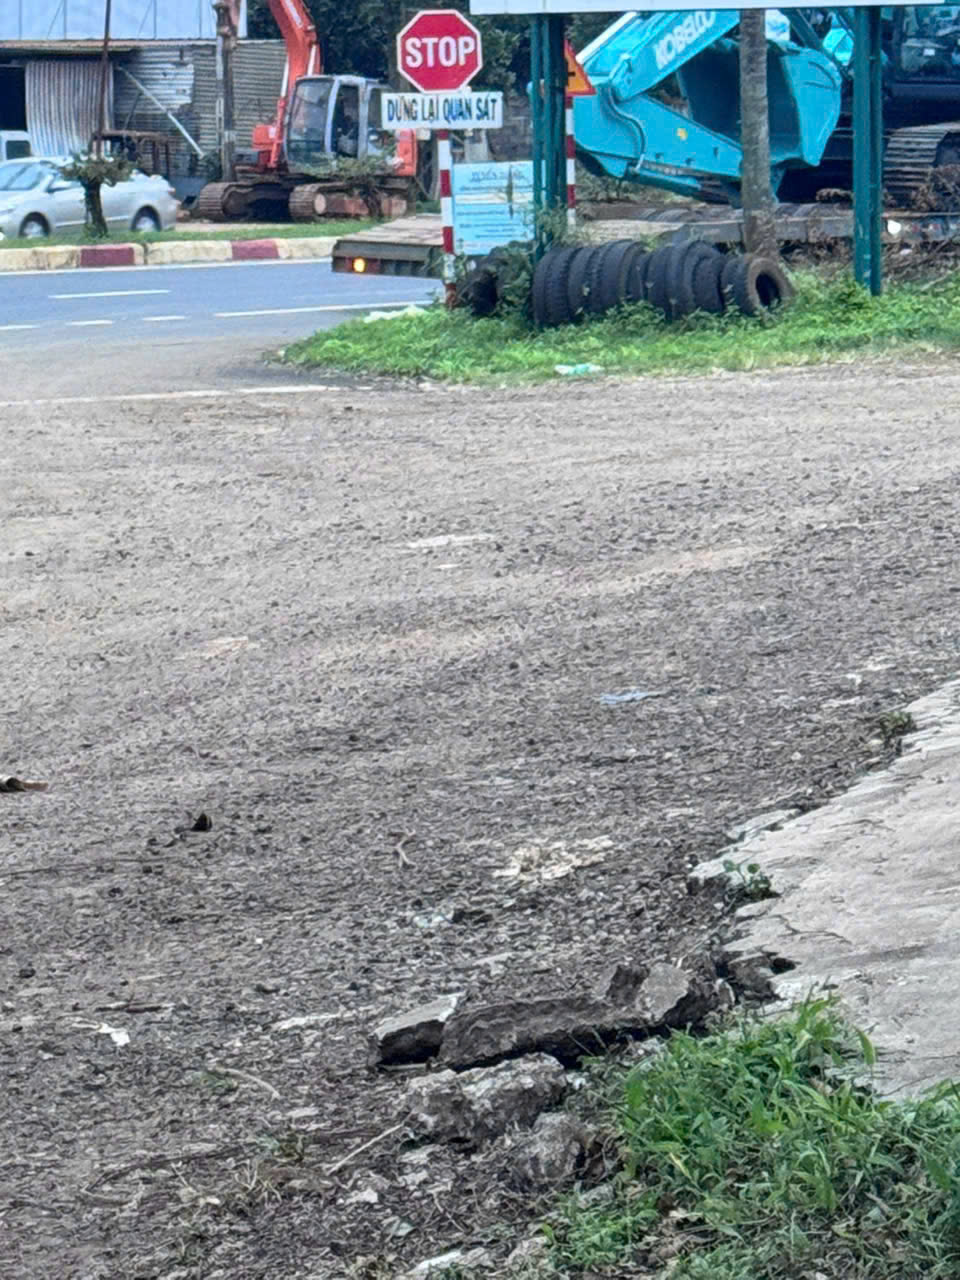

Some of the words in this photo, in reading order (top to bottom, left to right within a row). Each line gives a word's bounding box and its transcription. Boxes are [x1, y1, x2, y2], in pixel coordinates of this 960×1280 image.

[405, 36, 476, 68] STOP
[443, 98, 472, 124] QUAN
[476, 94, 497, 121] SÁT
